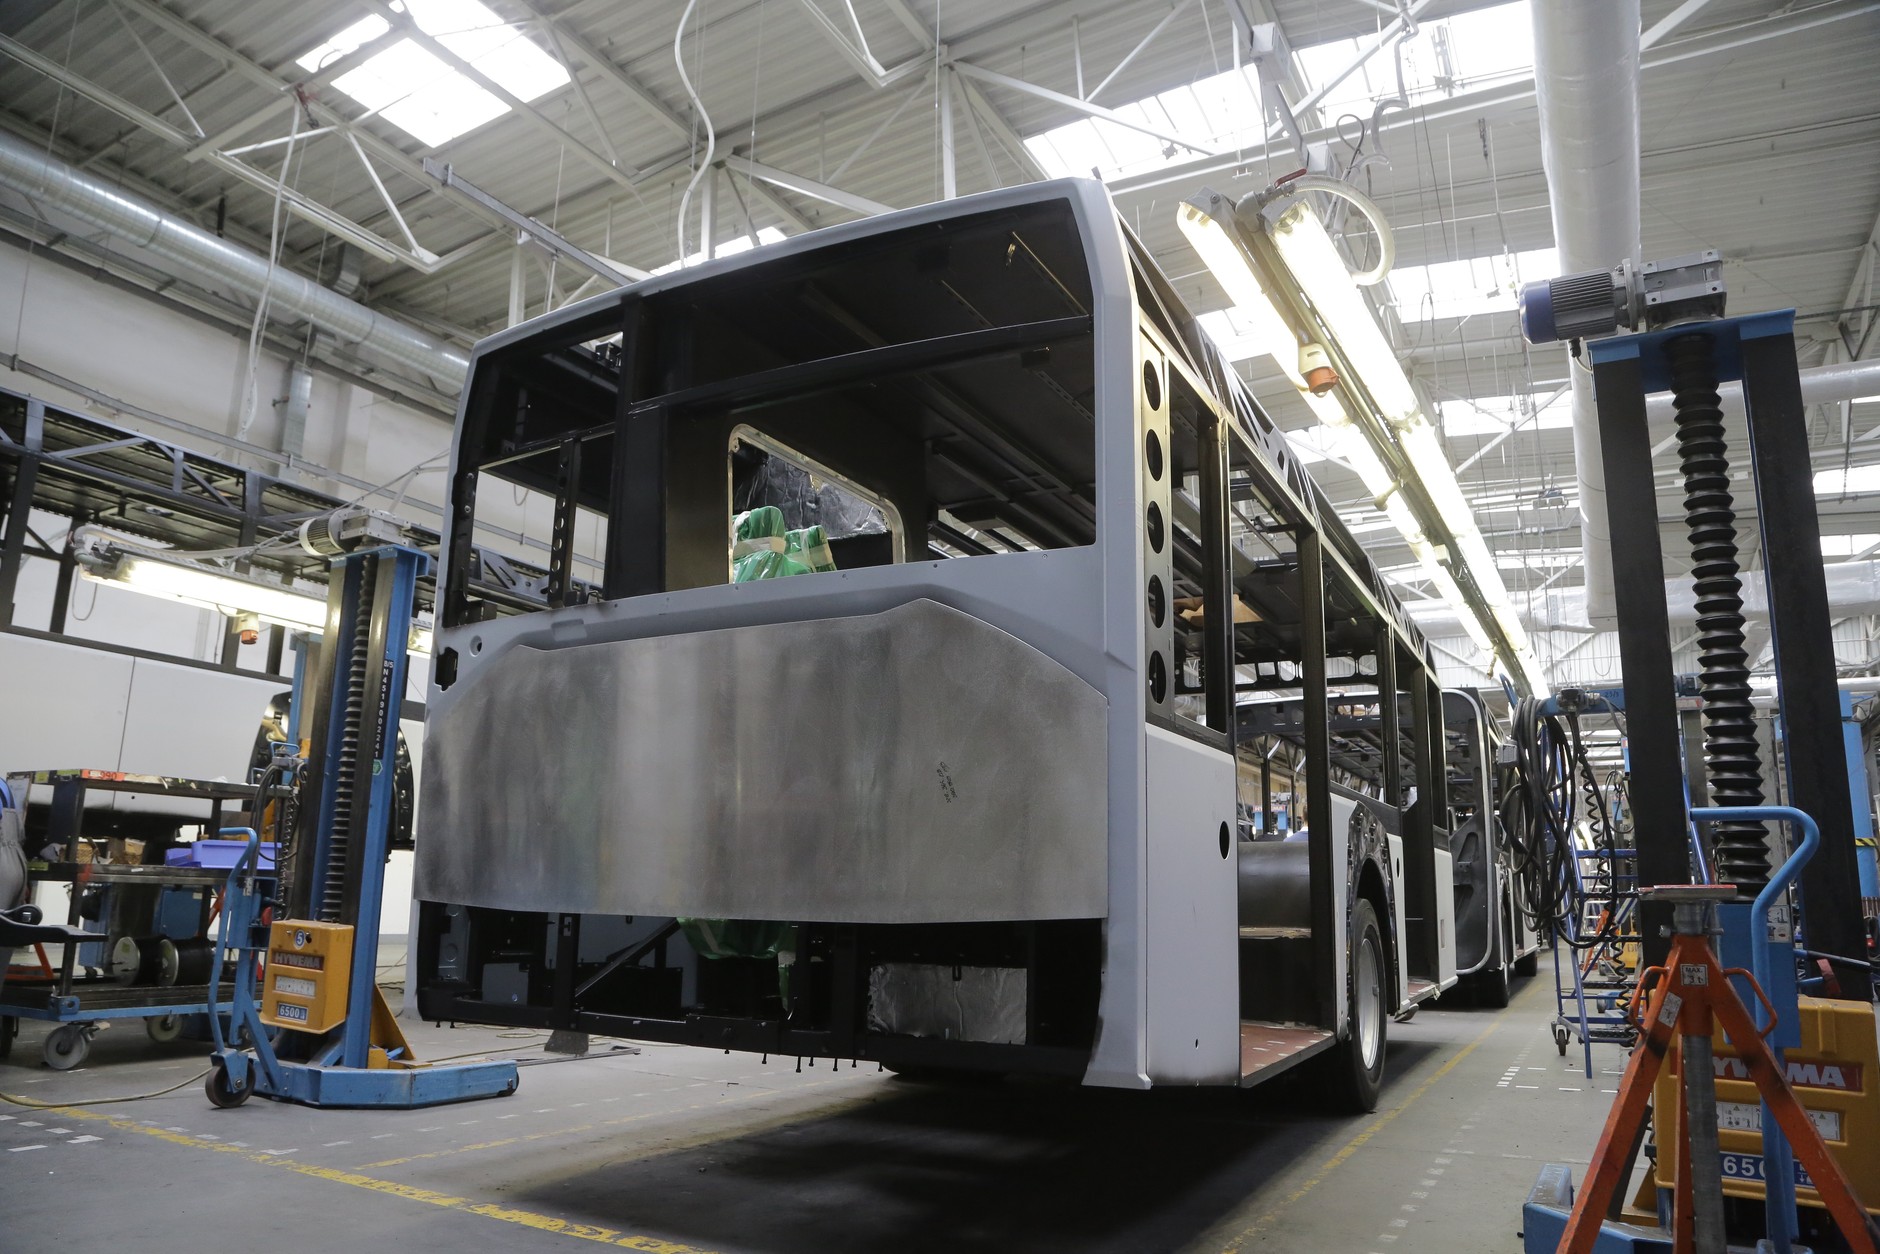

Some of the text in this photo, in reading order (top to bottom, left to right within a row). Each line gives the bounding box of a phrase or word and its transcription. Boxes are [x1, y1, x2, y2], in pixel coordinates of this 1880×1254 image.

[297, 933, 303, 944] 5
[275, 952, 320, 968] HYWEMA
[280, 1006, 299, 1017] 6500
